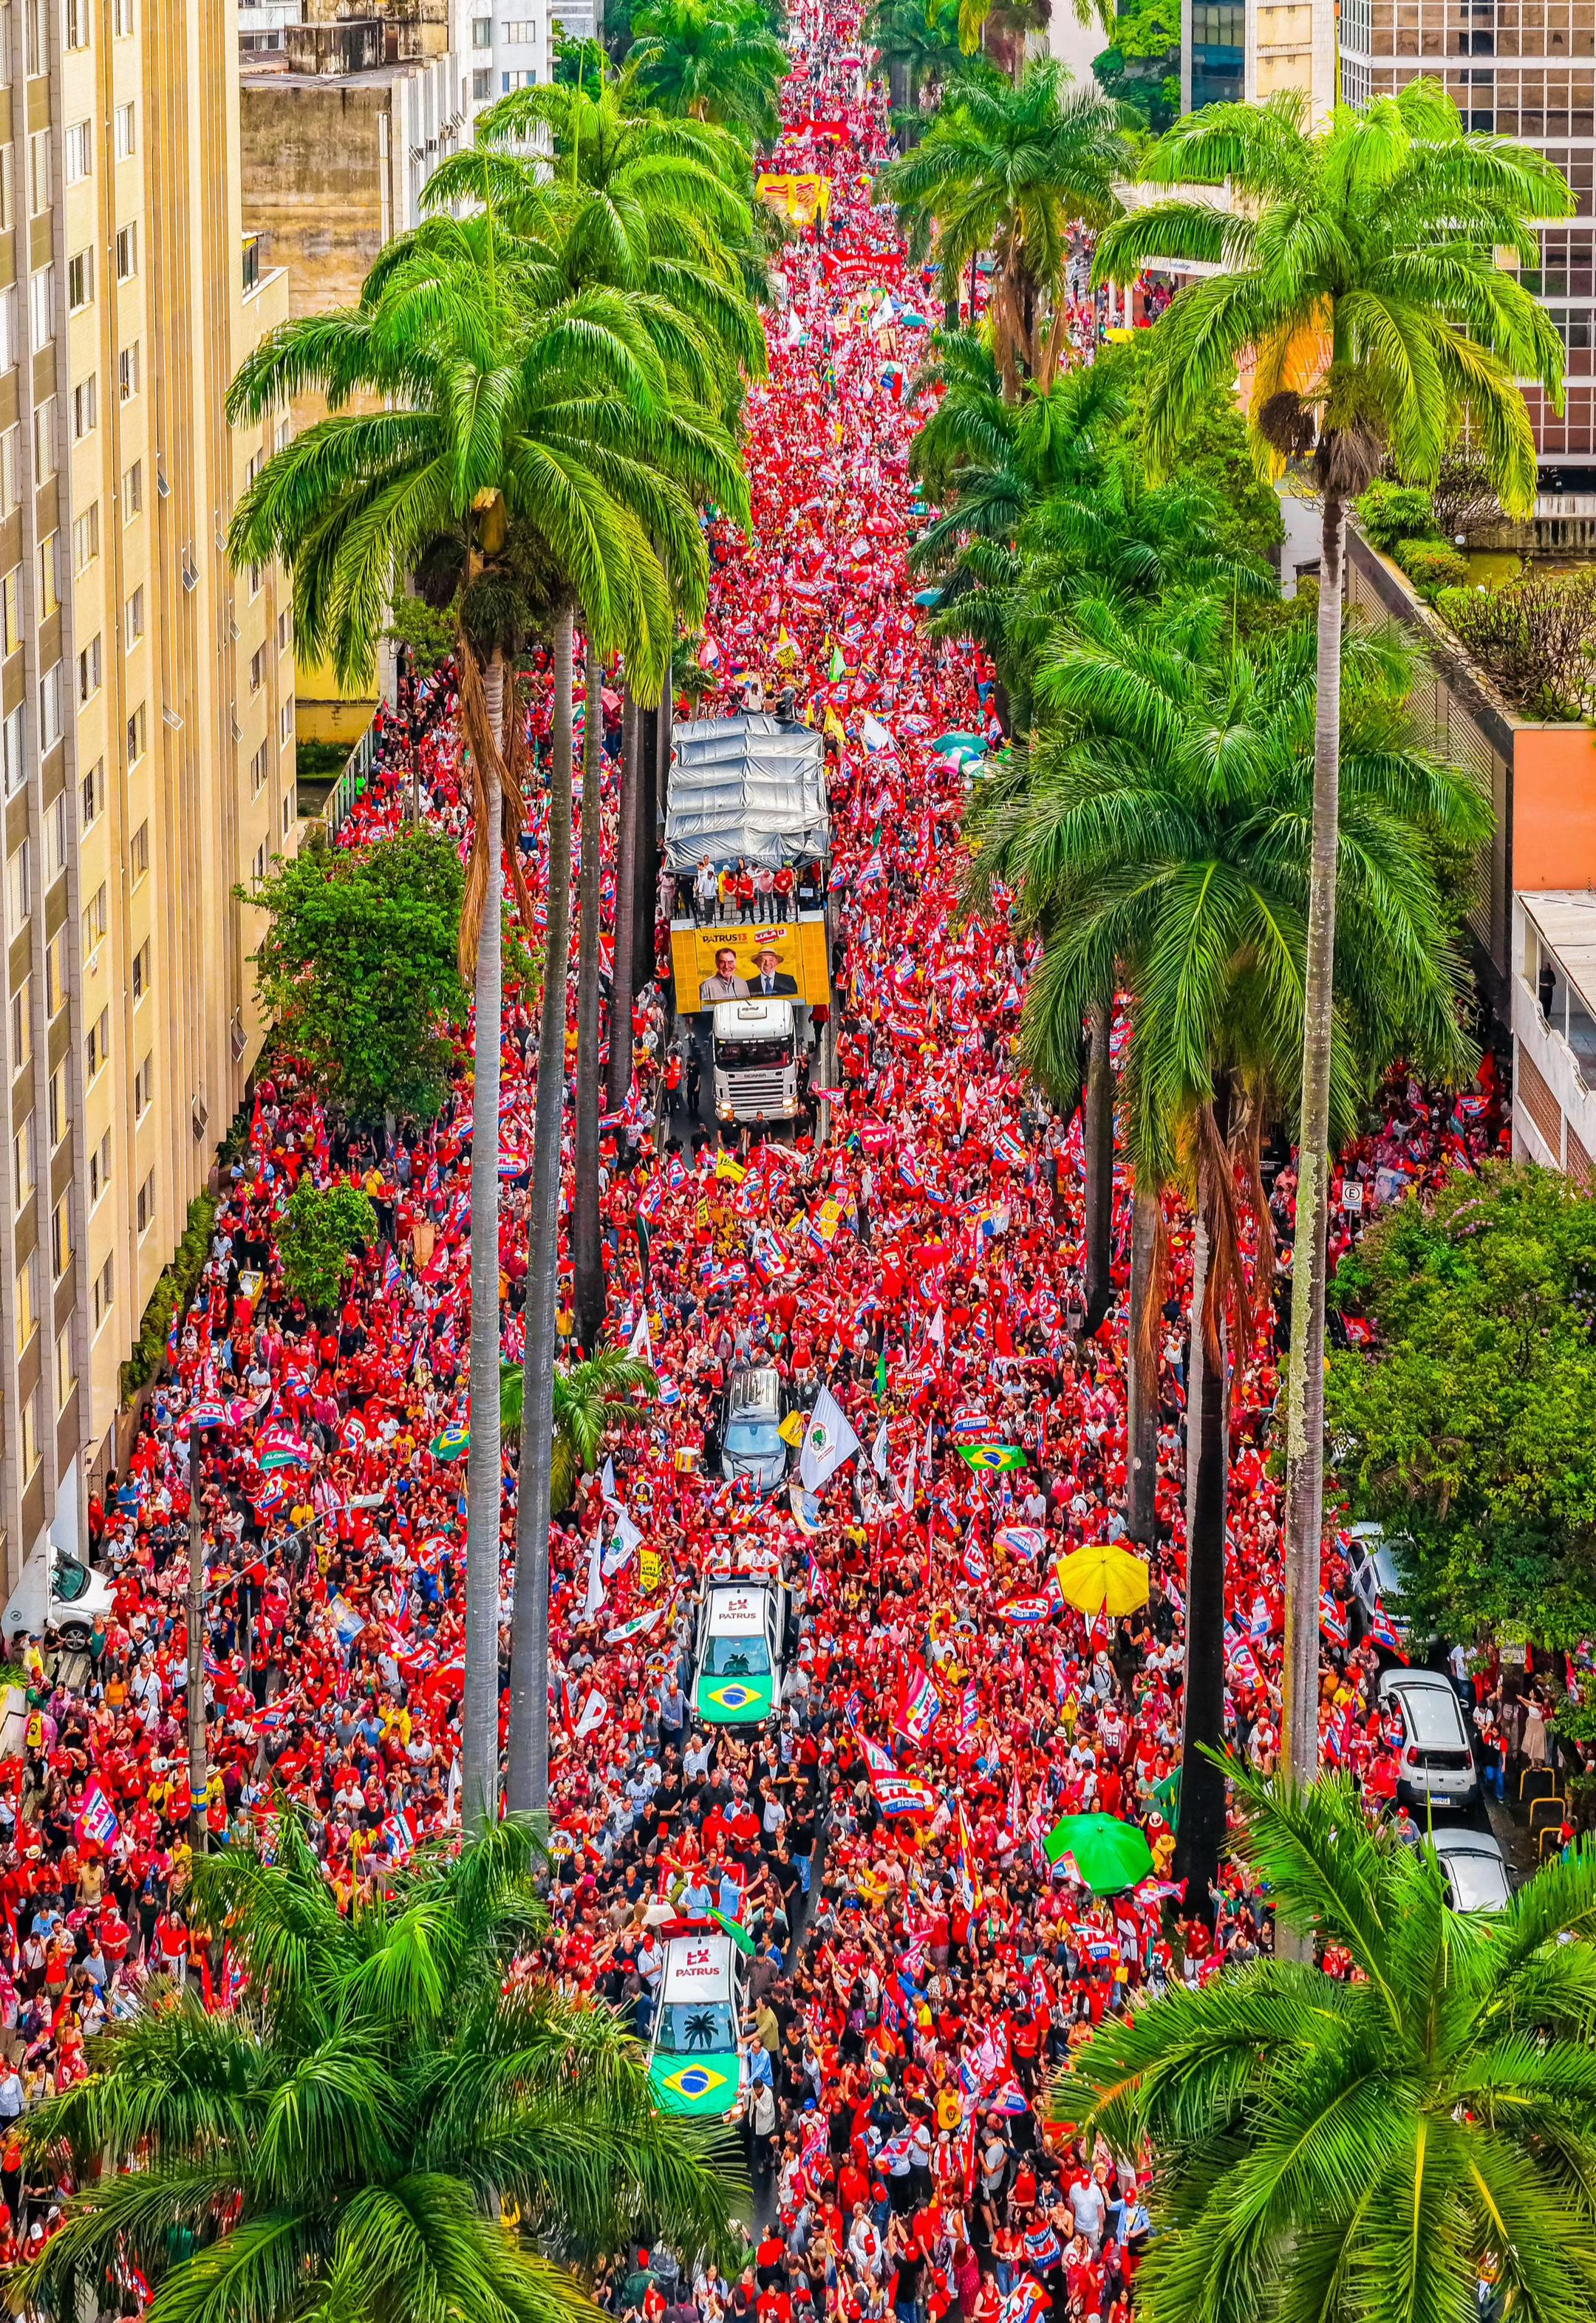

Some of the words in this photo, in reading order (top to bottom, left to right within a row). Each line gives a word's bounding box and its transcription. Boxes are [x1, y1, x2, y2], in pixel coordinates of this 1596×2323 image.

[755, 930, 777, 941] LULA
[1349, 1189, 1356, 1198] E
[267, 1432, 308, 1453] LULA
[1106, 1734, 1119, 1746] 99
[876, 1787, 926, 1803] LULA
[676, 1967, 720, 1976] PATRUS
